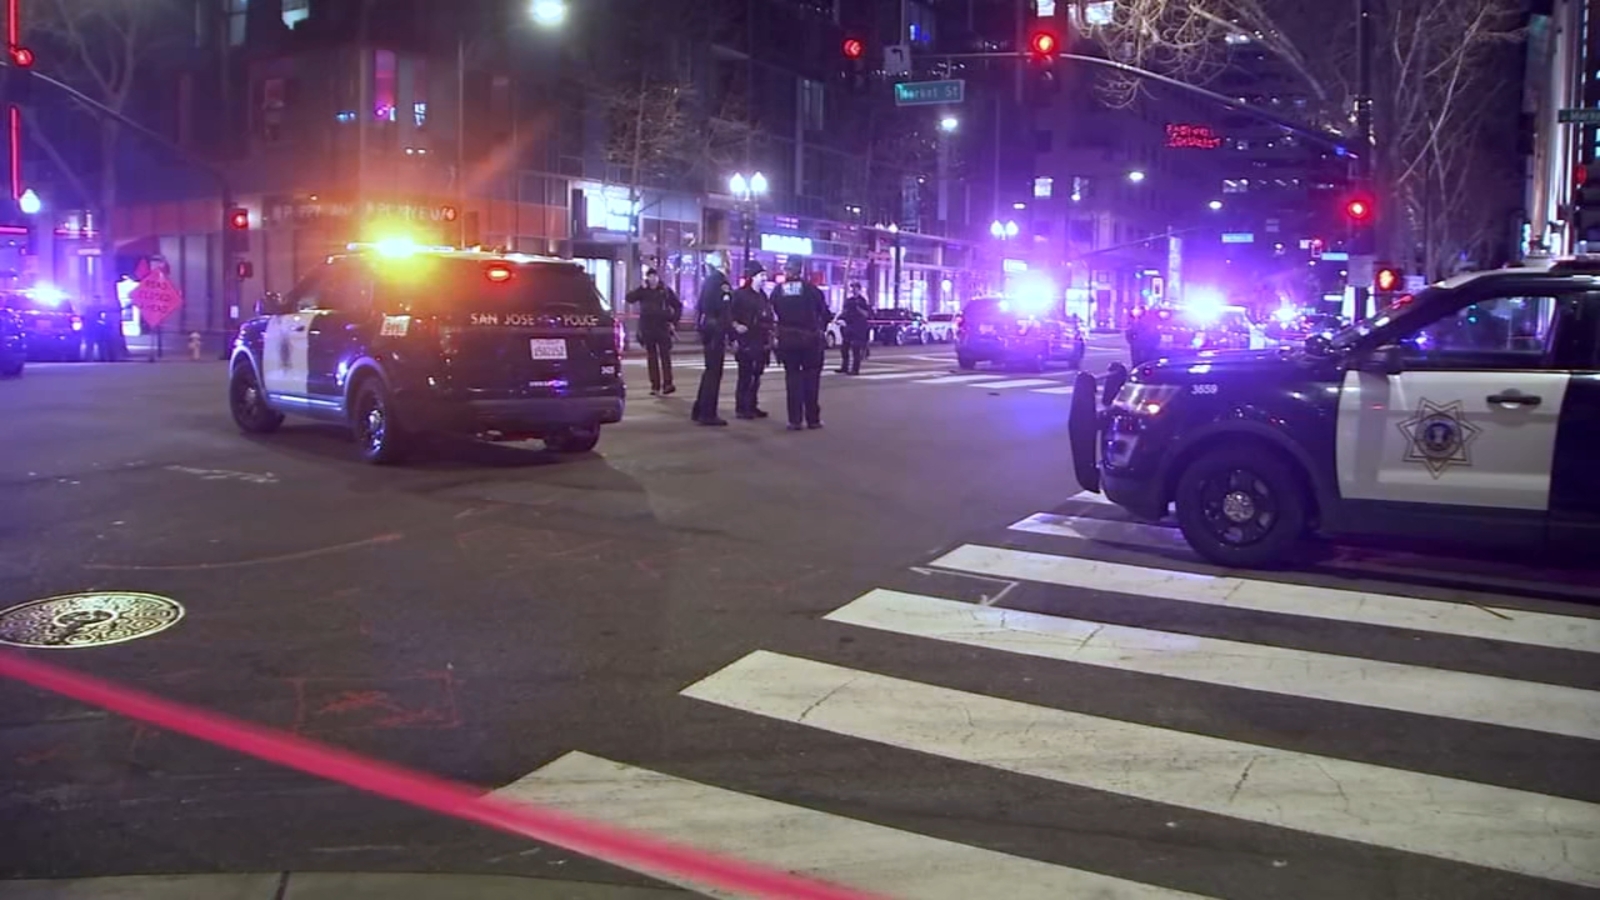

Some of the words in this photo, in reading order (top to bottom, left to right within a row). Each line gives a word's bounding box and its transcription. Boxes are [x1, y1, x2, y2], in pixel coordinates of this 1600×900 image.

[900, 88, 938, 100] Market
[945, 86, 958, 97] St
[470, 313, 499, 325] SAN
[504, 313, 535, 326] JOSE
[563, 314, 599, 326] POLICE
